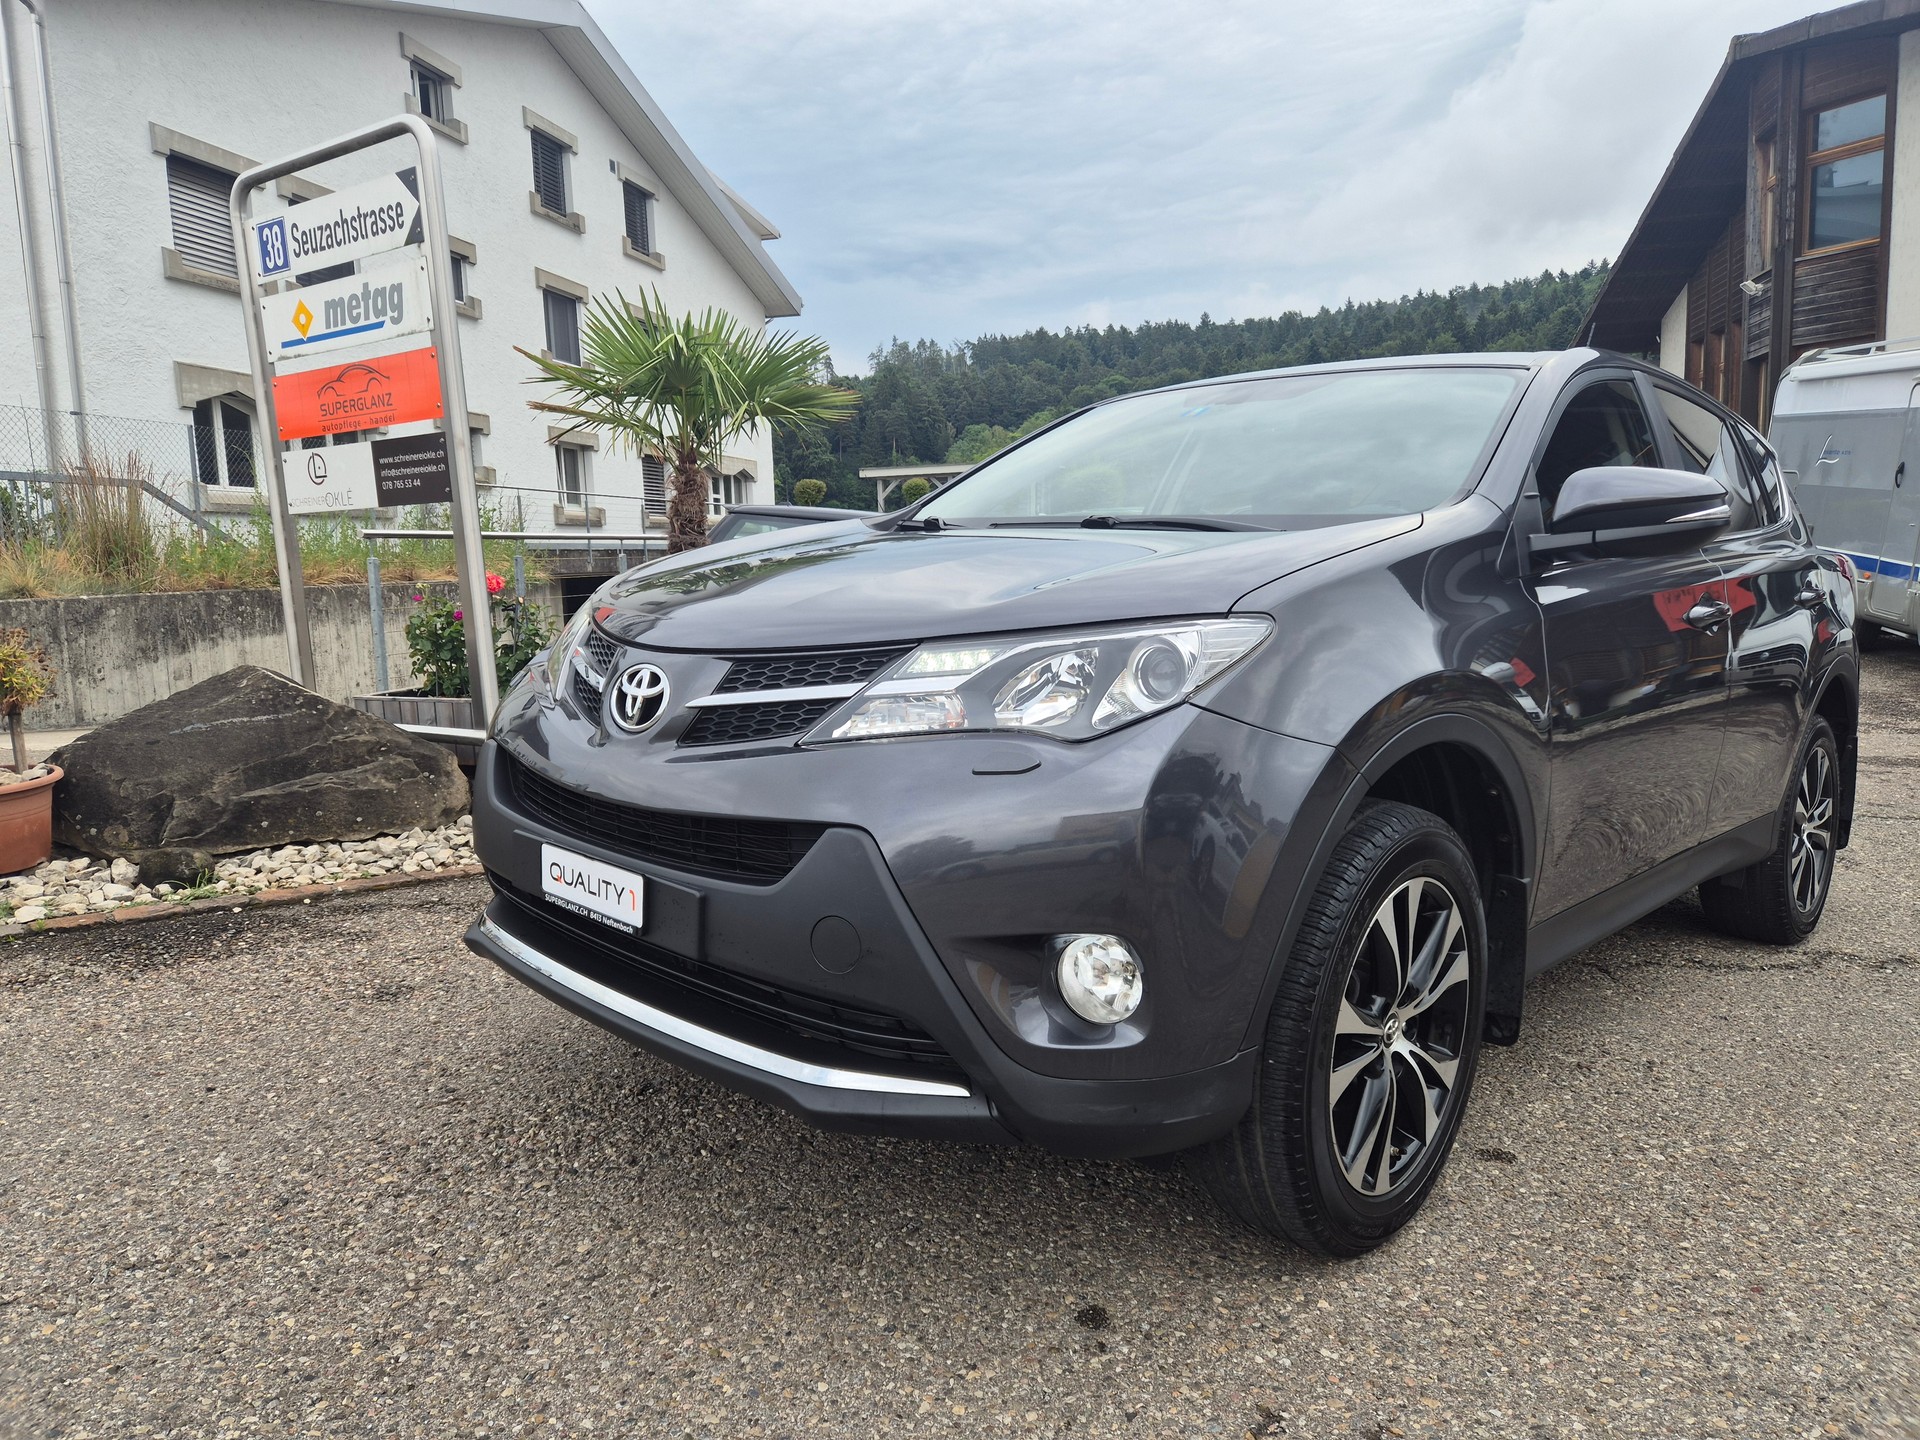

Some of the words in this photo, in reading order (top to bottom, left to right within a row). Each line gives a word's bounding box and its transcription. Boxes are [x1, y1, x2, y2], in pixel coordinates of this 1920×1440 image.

[262, 224, 284, 269] 38
[290, 201, 405, 258] Seuzachstrasse
[324, 282, 404, 330] metag
[320, 393, 393, 417] SUPERGLANZ
[321, 420, 361, 432] autopflege
[369, 413, 396, 425] handel
[379, 450, 444, 464] www.schreinereiokle.ch
[381, 463, 445, 476] info@schreinereiokle.ch
[382, 481, 393, 490] 078
[394, 480, 404, 488] 765
[405, 479, 412, 488] 53
[413, 478, 421, 487] 44
[545, 894, 588, 916] SUPERGLANZ.CH
[590, 911, 602, 921] 8413
[602, 917, 633, 934] Neftenbach
